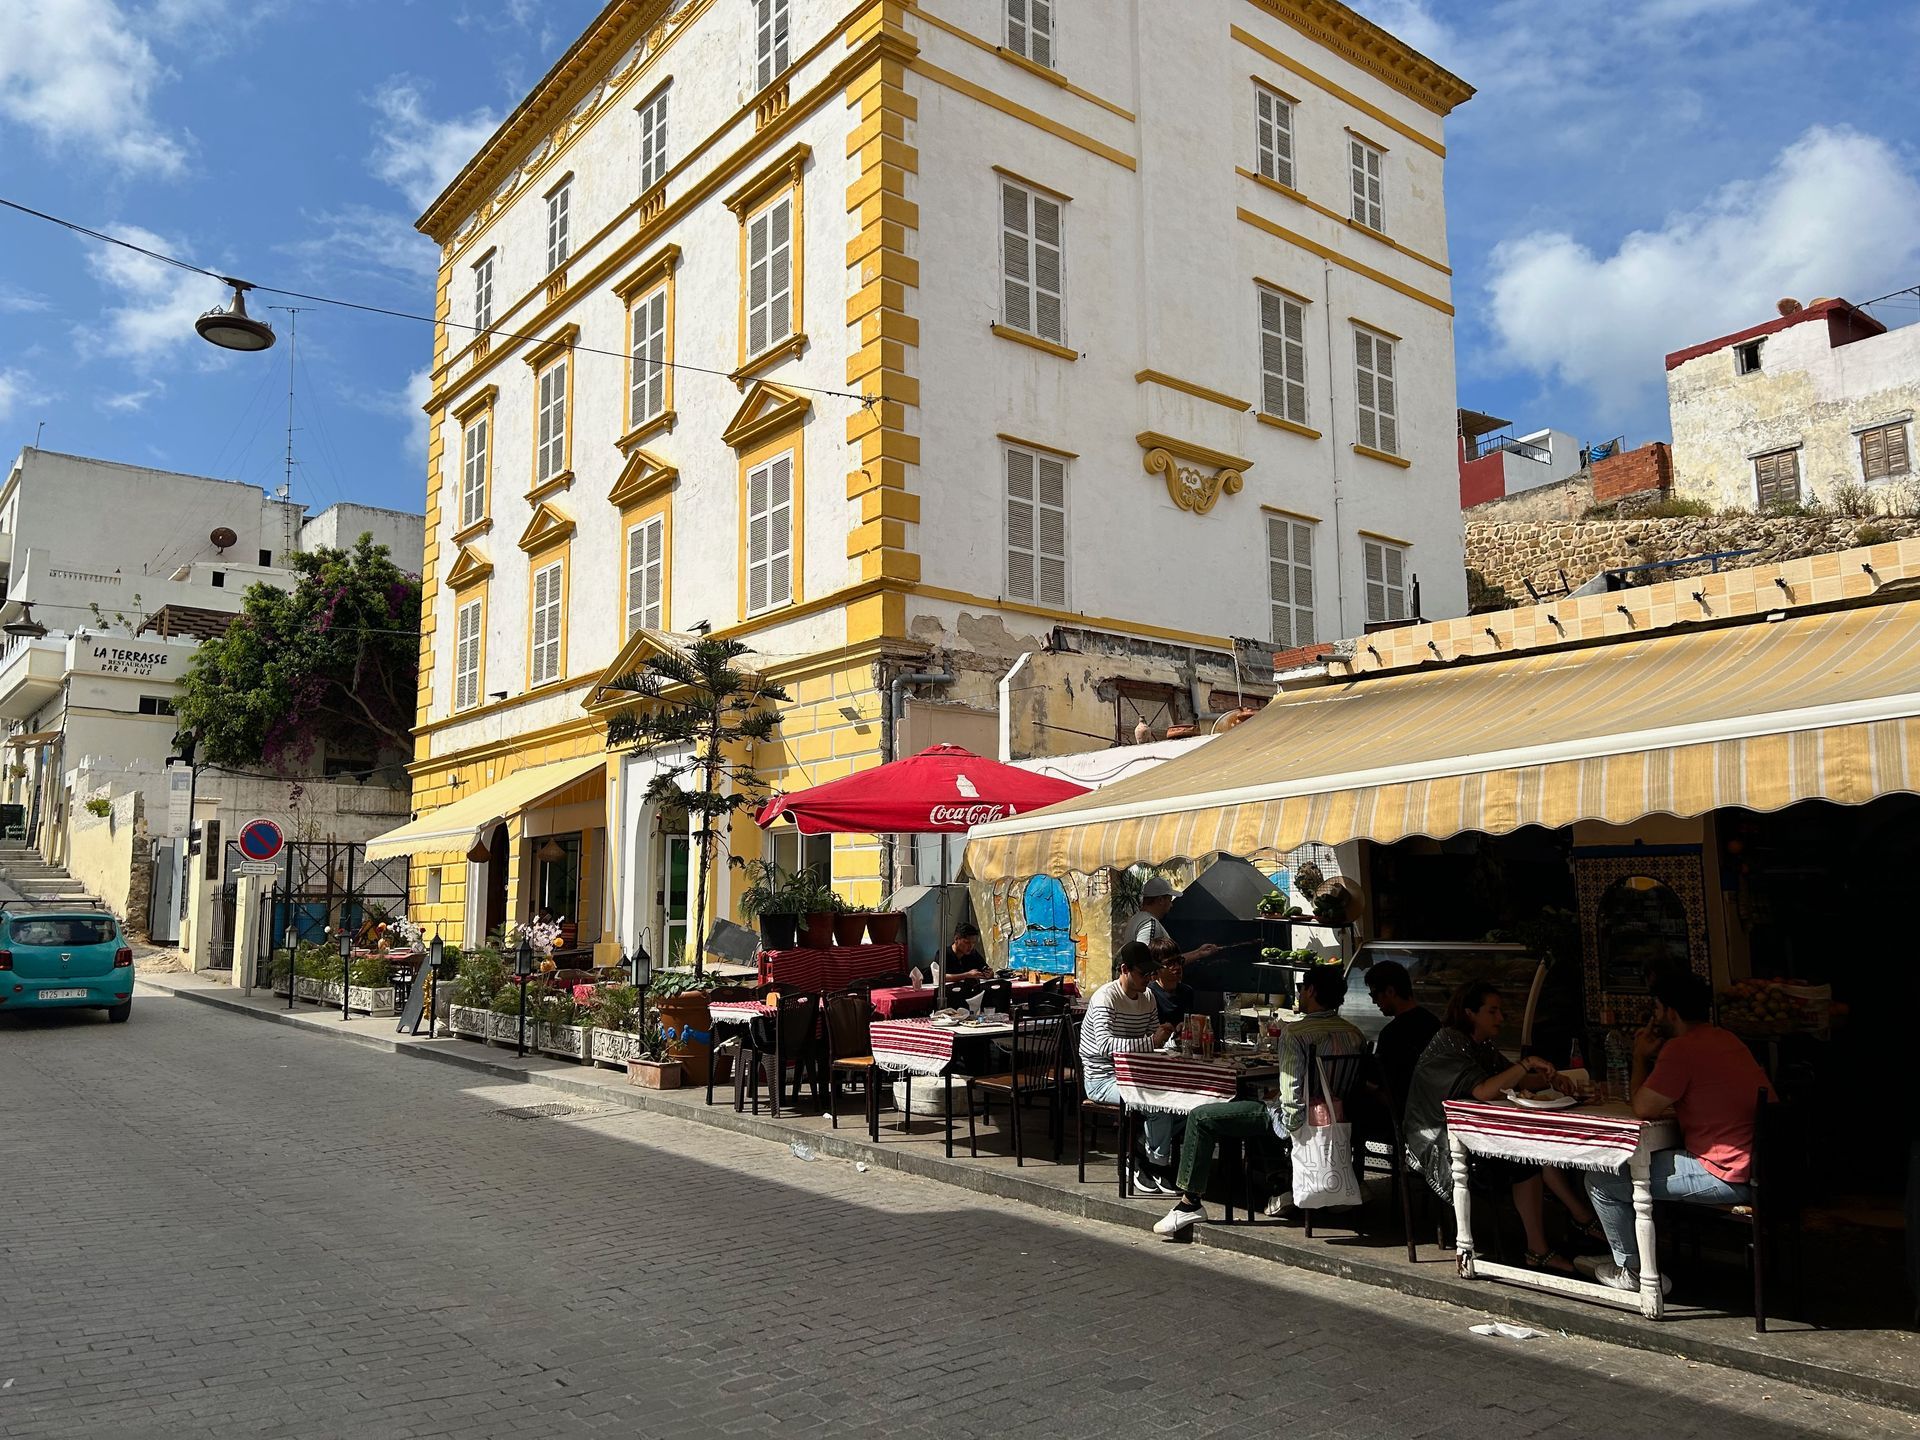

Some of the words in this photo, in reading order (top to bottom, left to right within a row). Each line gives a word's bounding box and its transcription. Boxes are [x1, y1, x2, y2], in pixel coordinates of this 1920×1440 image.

[94, 647, 107, 658] LA
[112, 649, 168, 665] TERRASSE
[101, 664, 119, 673] BAR
[108, 660, 153, 669] RESTAURANT
